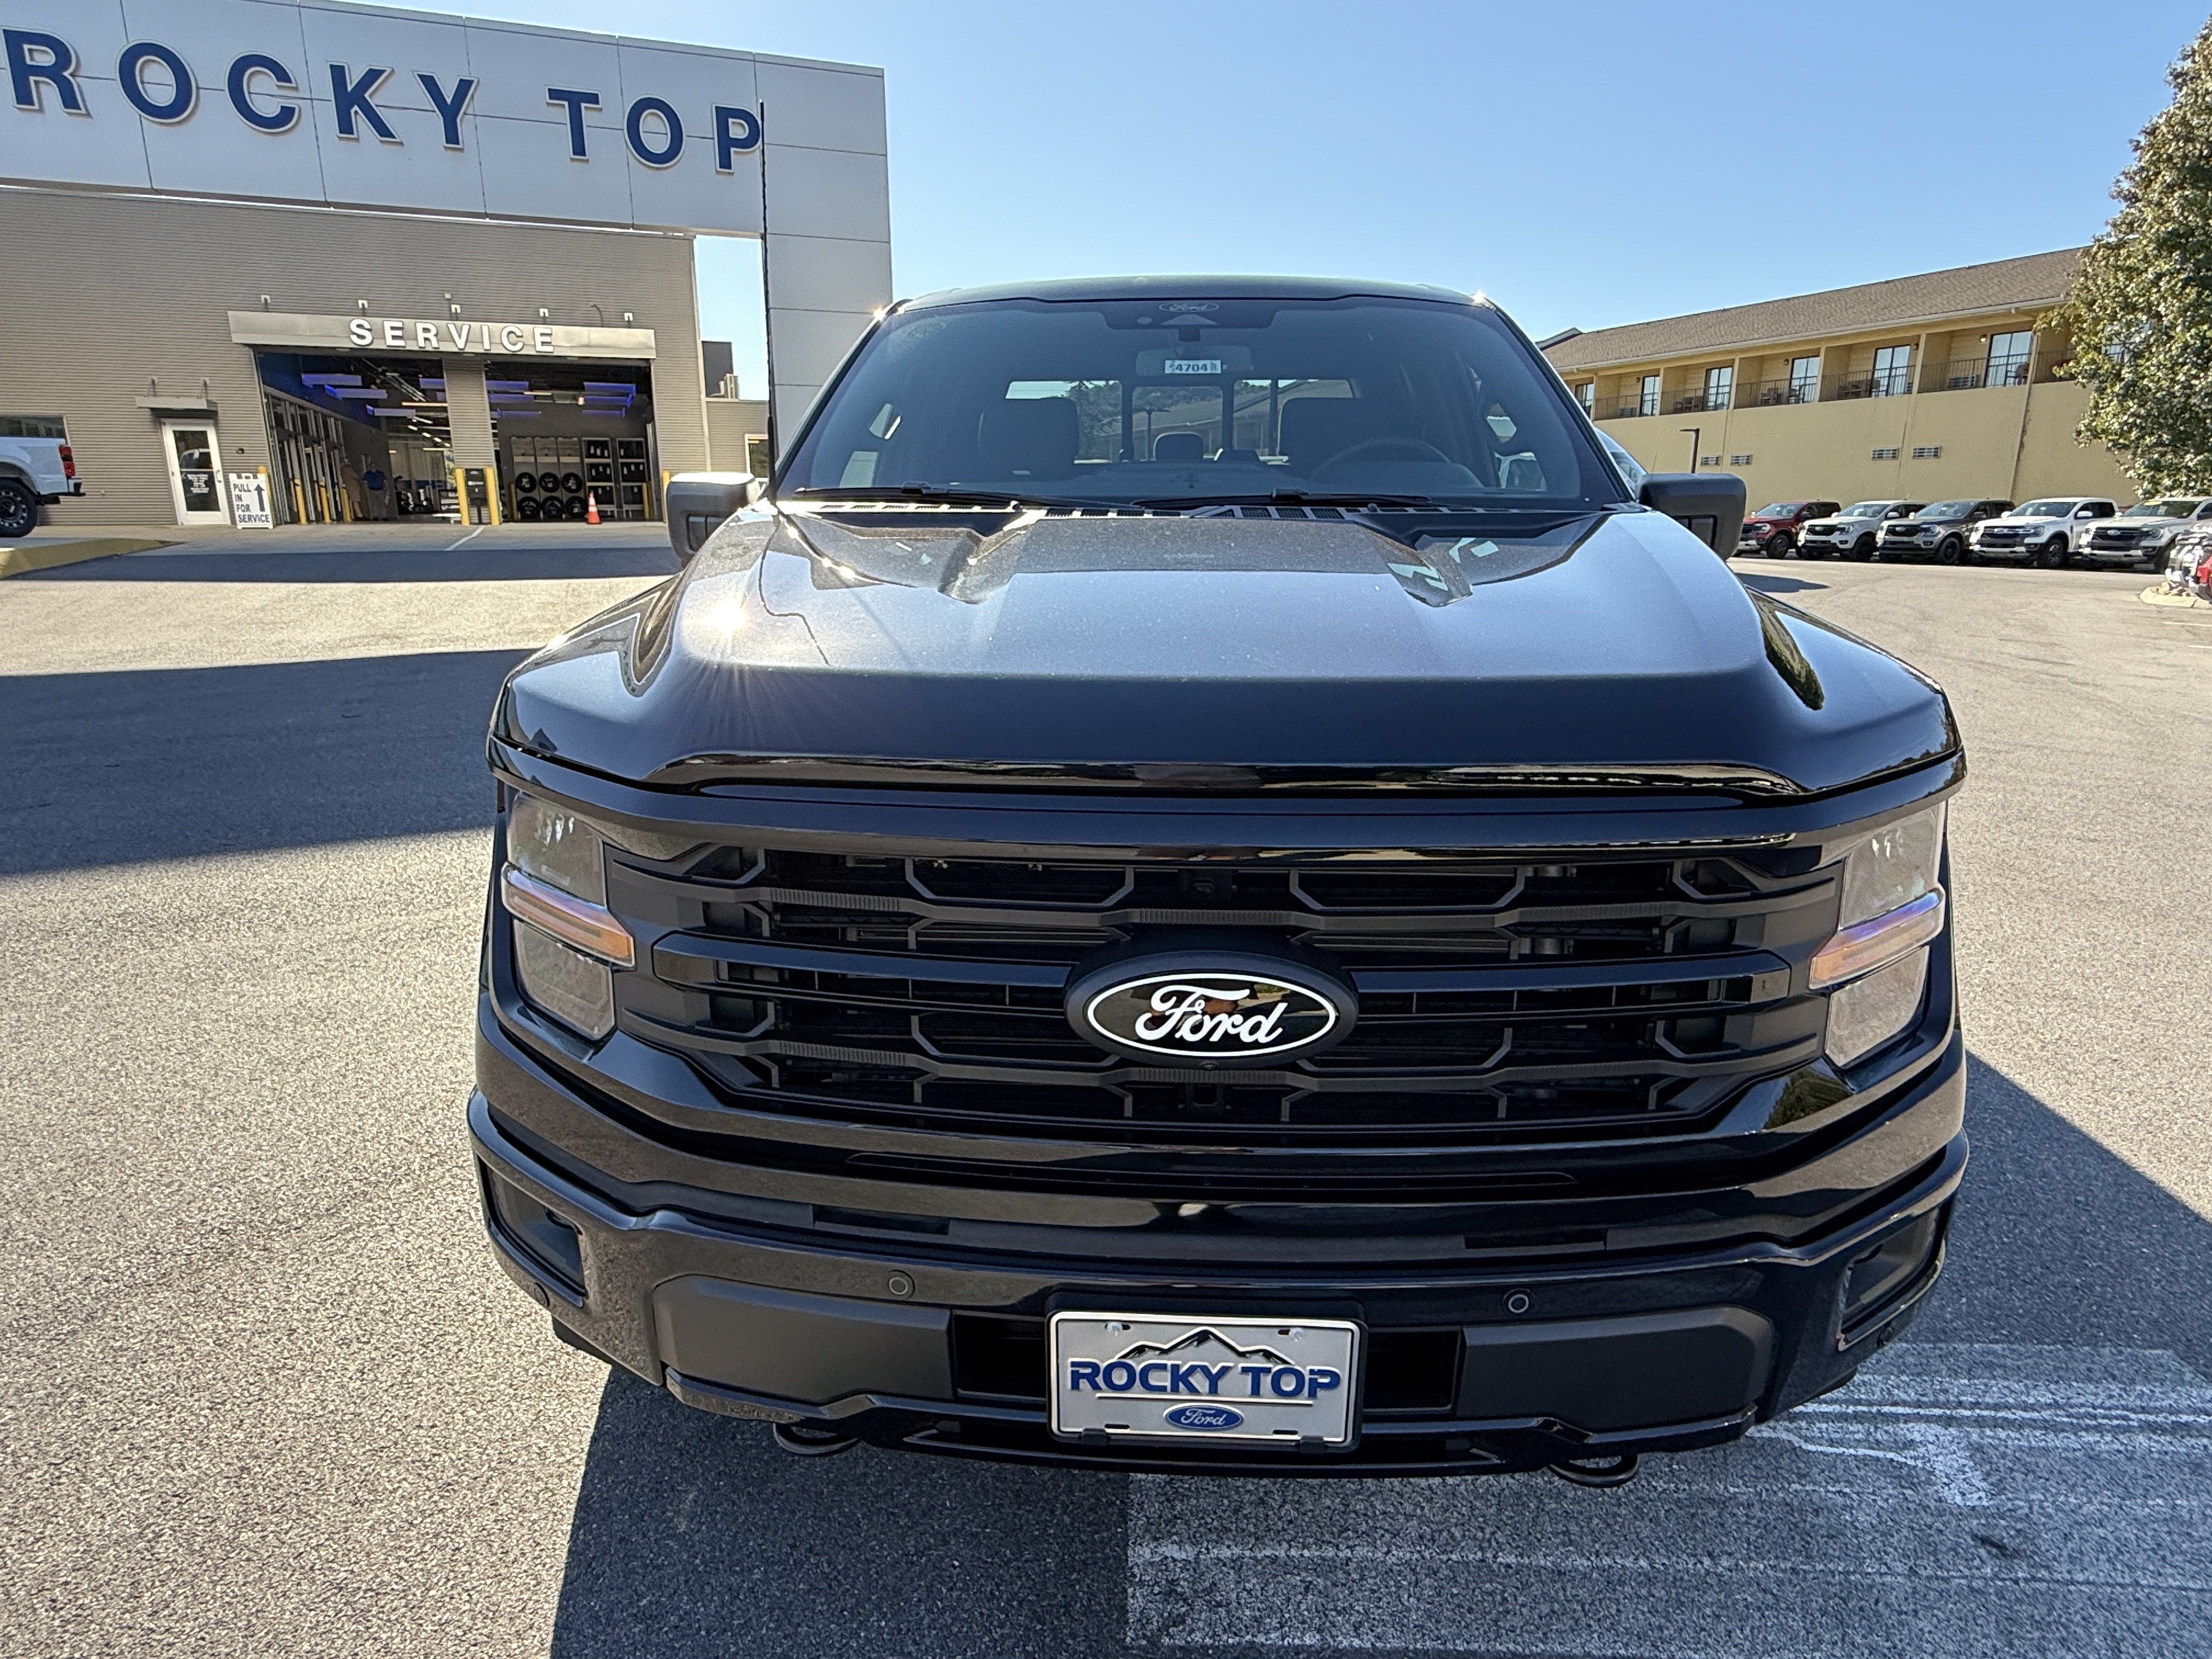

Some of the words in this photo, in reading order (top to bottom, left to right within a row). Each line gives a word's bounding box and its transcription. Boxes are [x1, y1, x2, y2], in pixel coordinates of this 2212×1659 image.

[2, 26, 479, 150] ROCKY
[545, 85, 761, 174] TOP
[349, 318, 555, 353] SERVICE
[1175, 363, 1207, 372] 4704
[233, 483, 251, 492] PULL
[236, 504, 251, 512] FOR
[238, 514, 270, 523] SERVICE
[1135, 985, 1288, 1043] Ford
[1069, 1358, 1233, 1395] ROCKY
[1239, 1362, 1341, 1398] TOP
[1181, 1408, 1227, 1426] Ford
